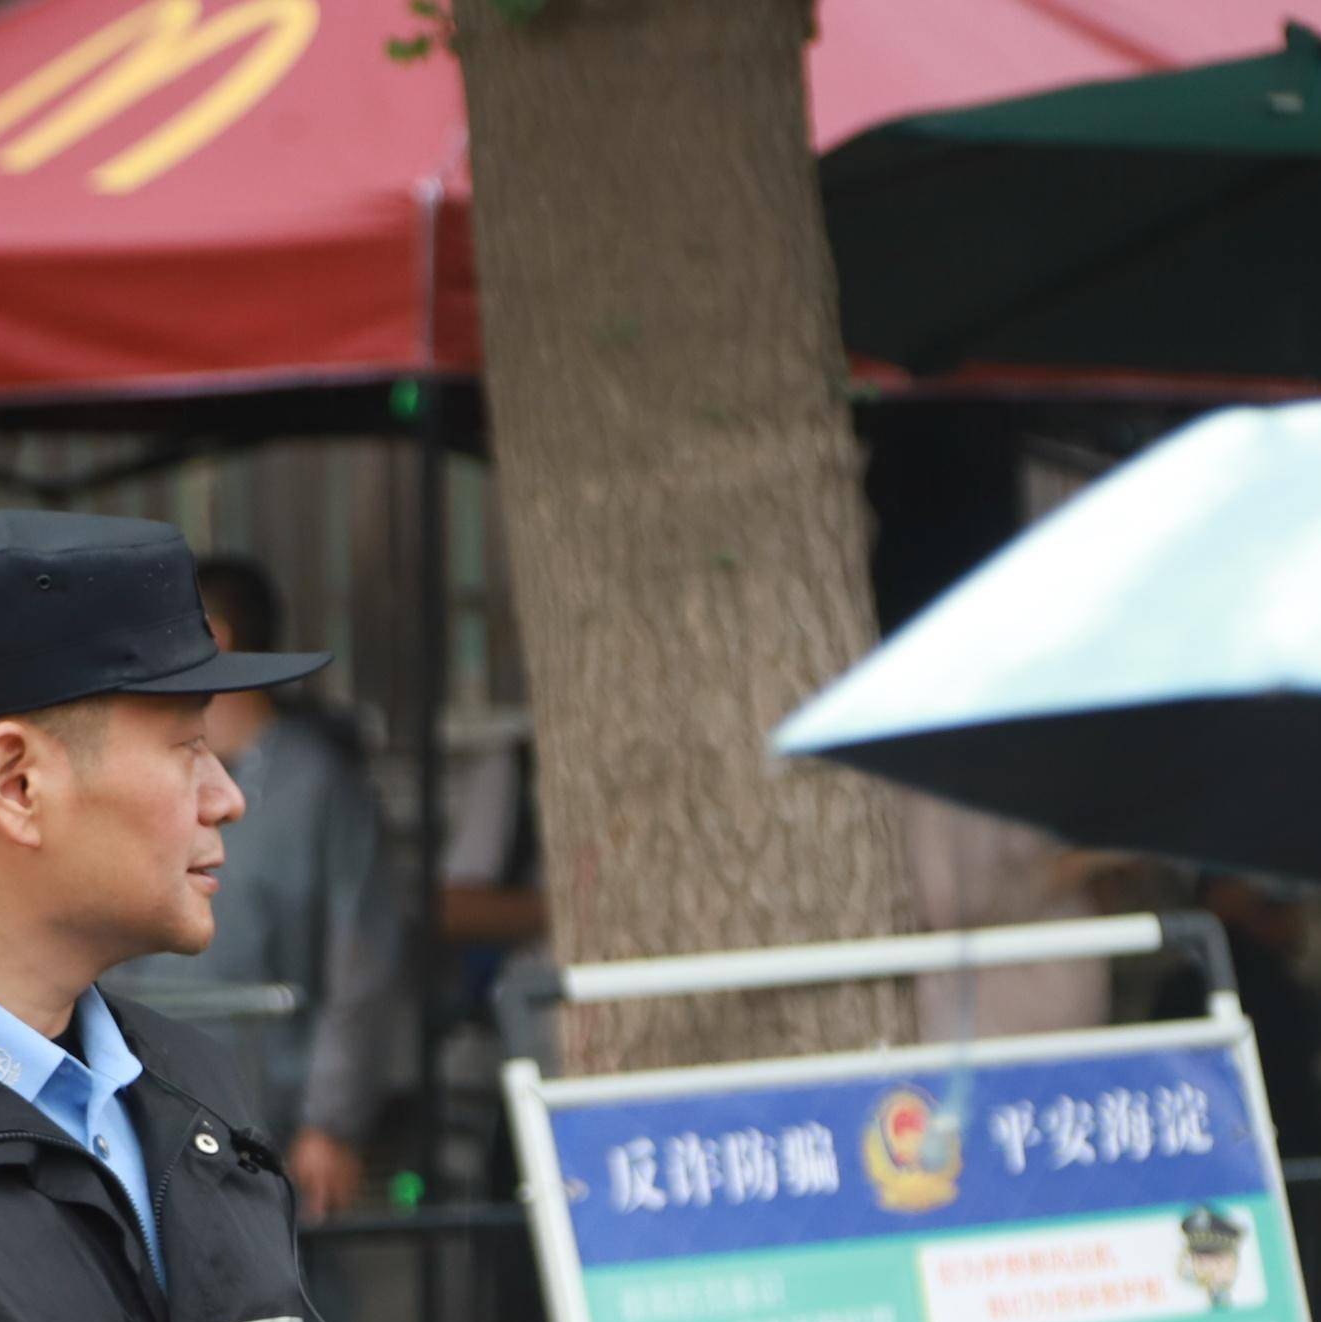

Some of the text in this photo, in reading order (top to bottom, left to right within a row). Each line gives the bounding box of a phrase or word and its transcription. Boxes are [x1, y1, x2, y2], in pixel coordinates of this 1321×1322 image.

[607, 1080, 1215, 1214] 反诈防骗 平安海淀
